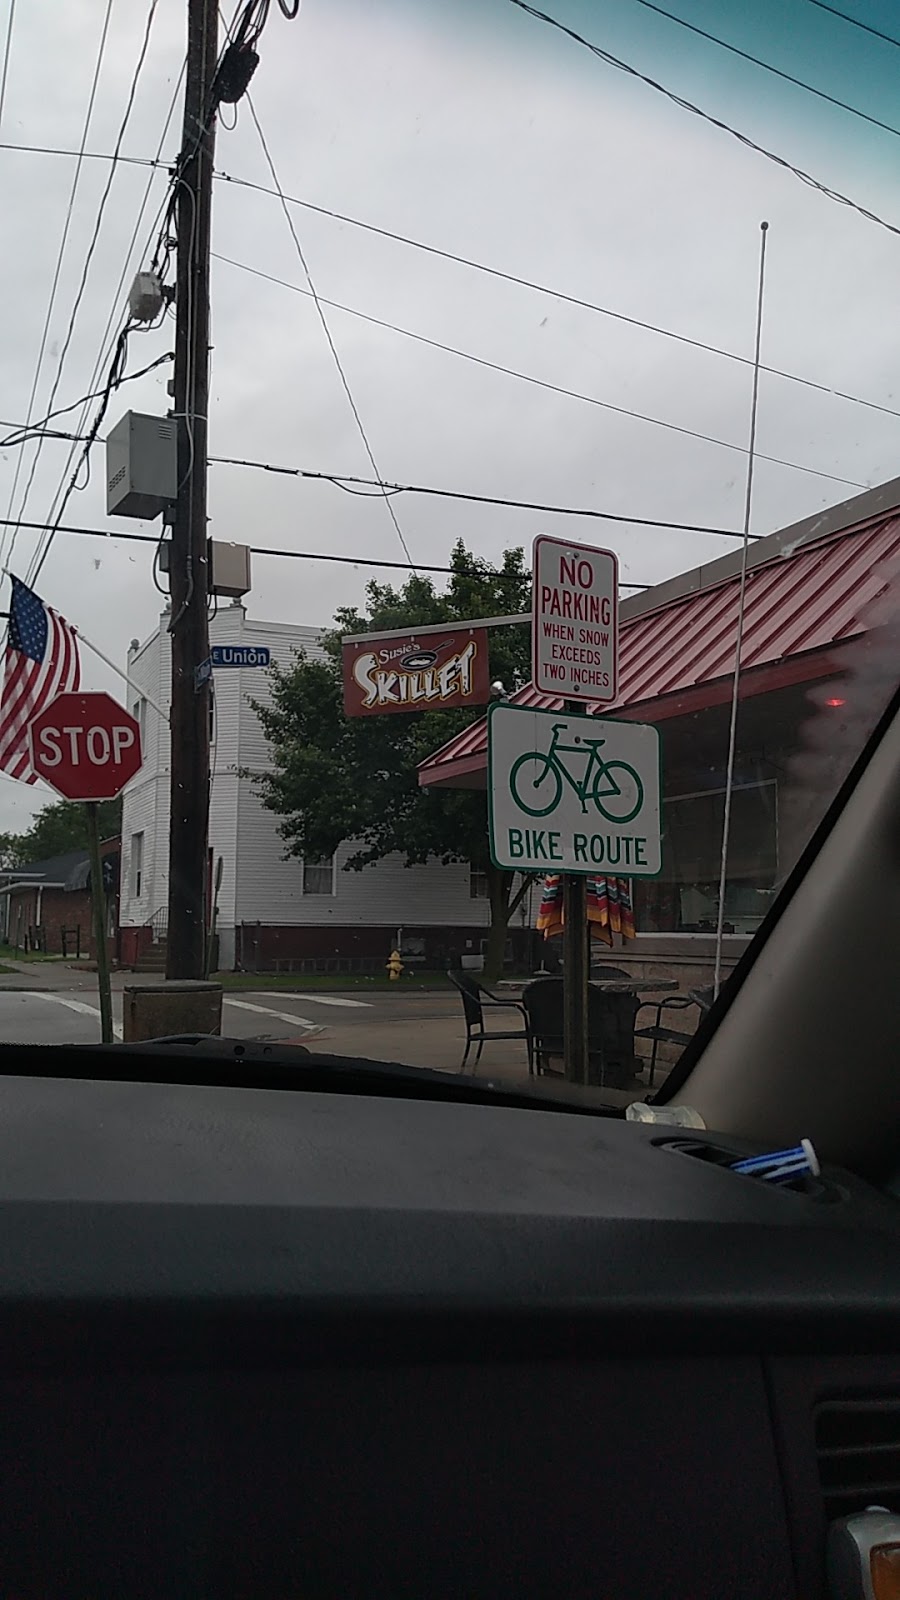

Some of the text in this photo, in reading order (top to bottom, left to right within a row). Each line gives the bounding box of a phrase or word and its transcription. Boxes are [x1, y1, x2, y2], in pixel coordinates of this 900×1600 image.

[560, 556, 593, 589] NO
[542, 585, 611, 626] PARKING
[543, 622, 609, 647] WHEN SNOW
[213, 649, 267, 663] E Union
[379, 642, 421, 664] Susie's
[552, 644, 601, 665] EXCEEDS
[353, 641, 477, 709] SKILLET
[543, 663, 610, 687] TWO INCHES
[39, 726, 135, 767] STOP
[508, 828, 648, 865] BIKE ROUTE
